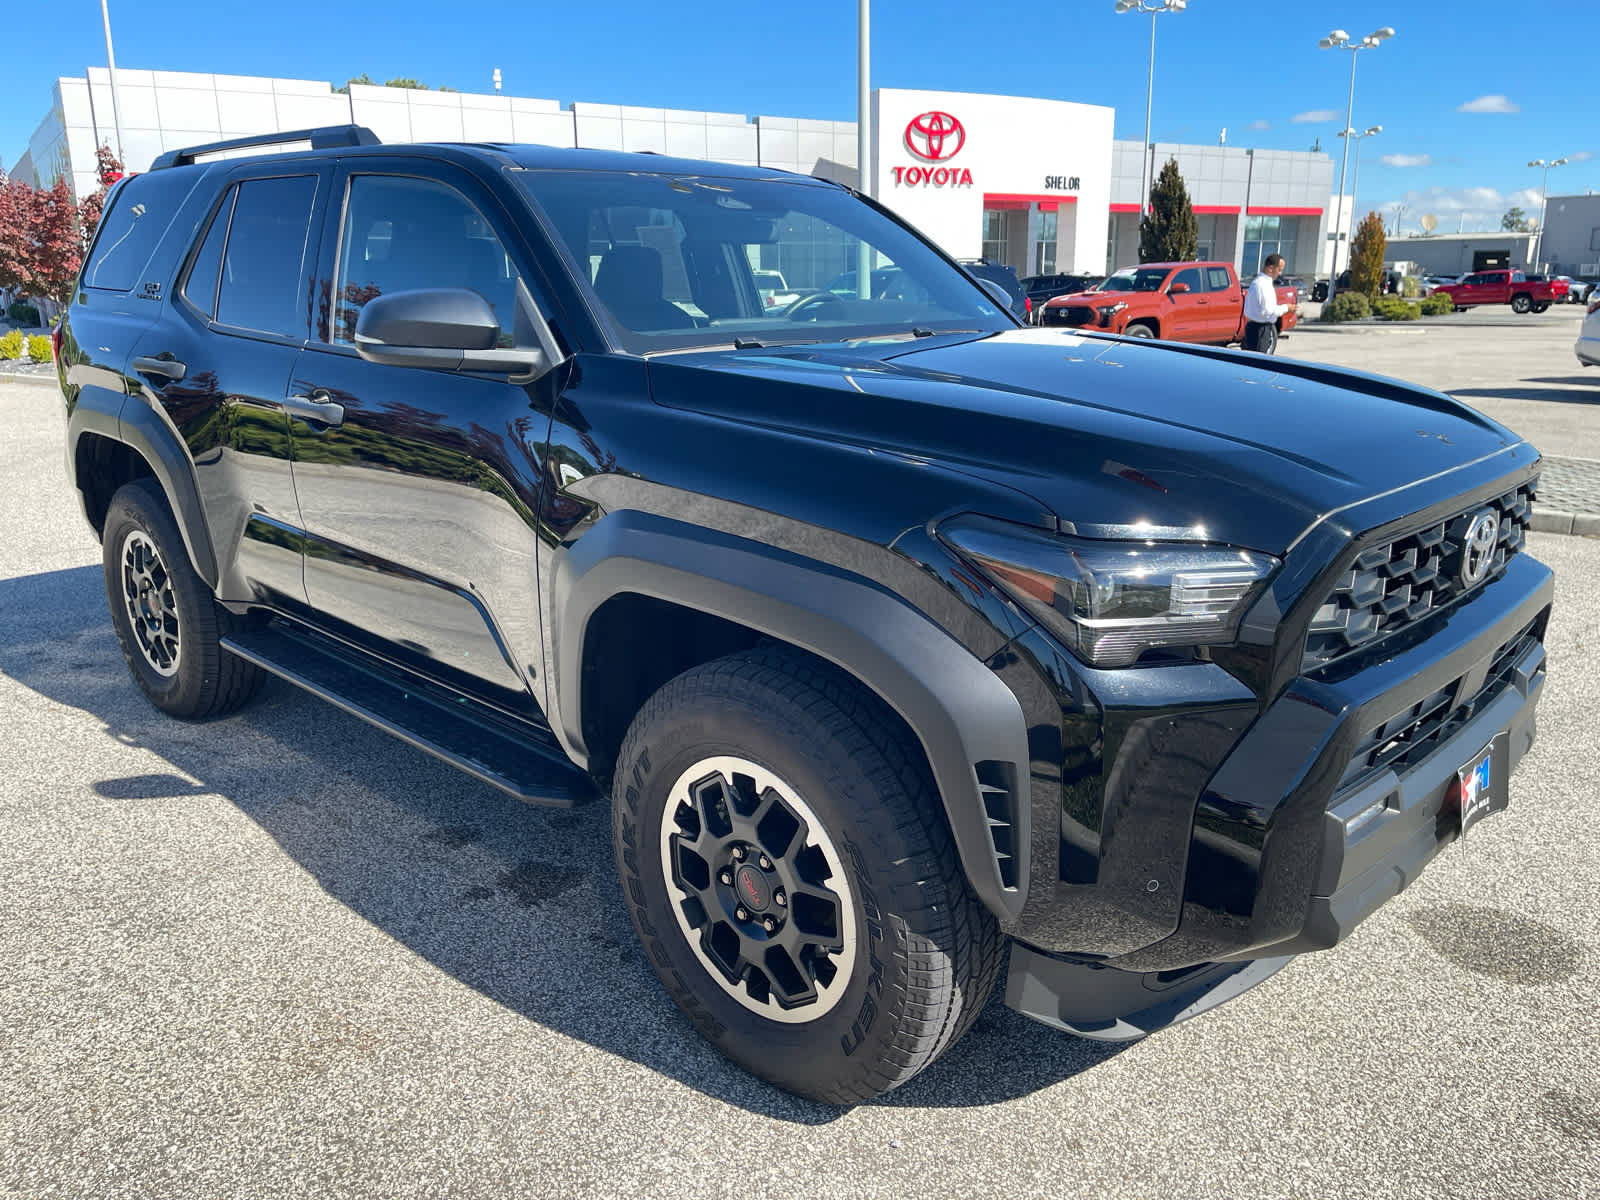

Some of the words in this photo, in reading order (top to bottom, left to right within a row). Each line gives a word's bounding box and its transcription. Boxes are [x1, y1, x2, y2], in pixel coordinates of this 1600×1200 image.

[892, 166, 974, 186] TOYOTA
[1044, 175, 1081, 191] SHELOR
[840, 831, 885, 1057] FALKEN
